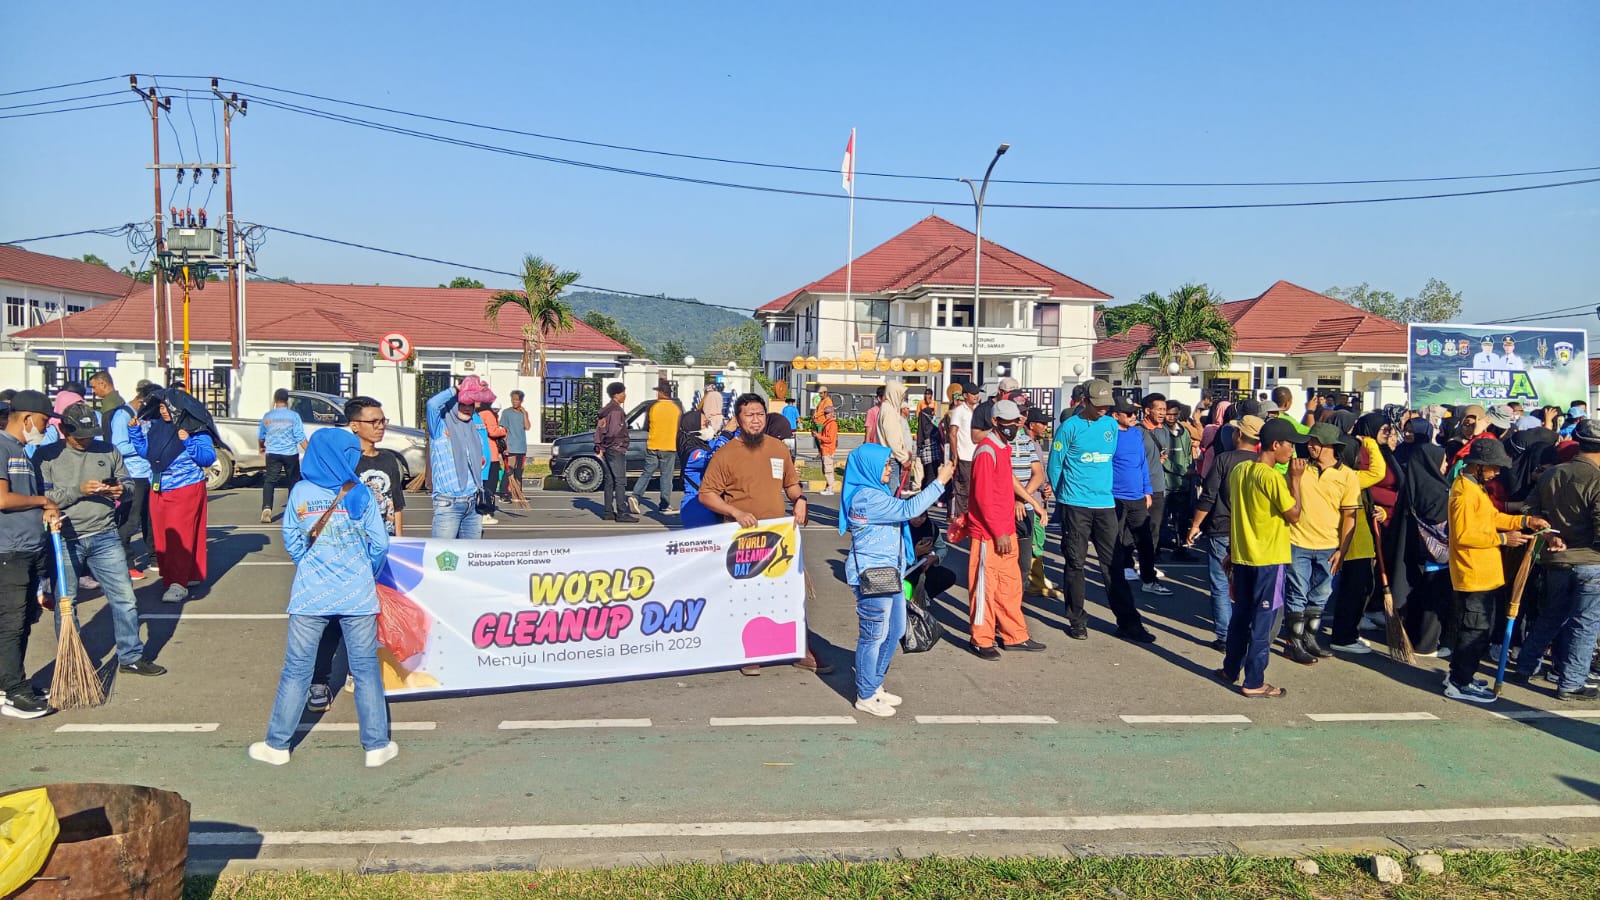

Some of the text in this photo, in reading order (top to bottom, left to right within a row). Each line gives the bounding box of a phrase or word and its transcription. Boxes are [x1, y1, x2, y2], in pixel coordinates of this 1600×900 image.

[388, 338, 403, 357] P
[679, 539, 713, 547] Konawe
[679, 544, 722, 553] Bersahaja
[738, 535, 767, 550] WORLD
[467, 548, 571, 559] Dinas Koperasi dan UKM
[468, 558, 551, 568] Kabupaten Konawe
[734, 562, 751, 577] DAY
[529, 566, 653, 606] WORLD
[472, 597, 706, 649] CLEANUP DAY
[478, 636, 702, 667] Menuju Indonesia Bersih 2029
